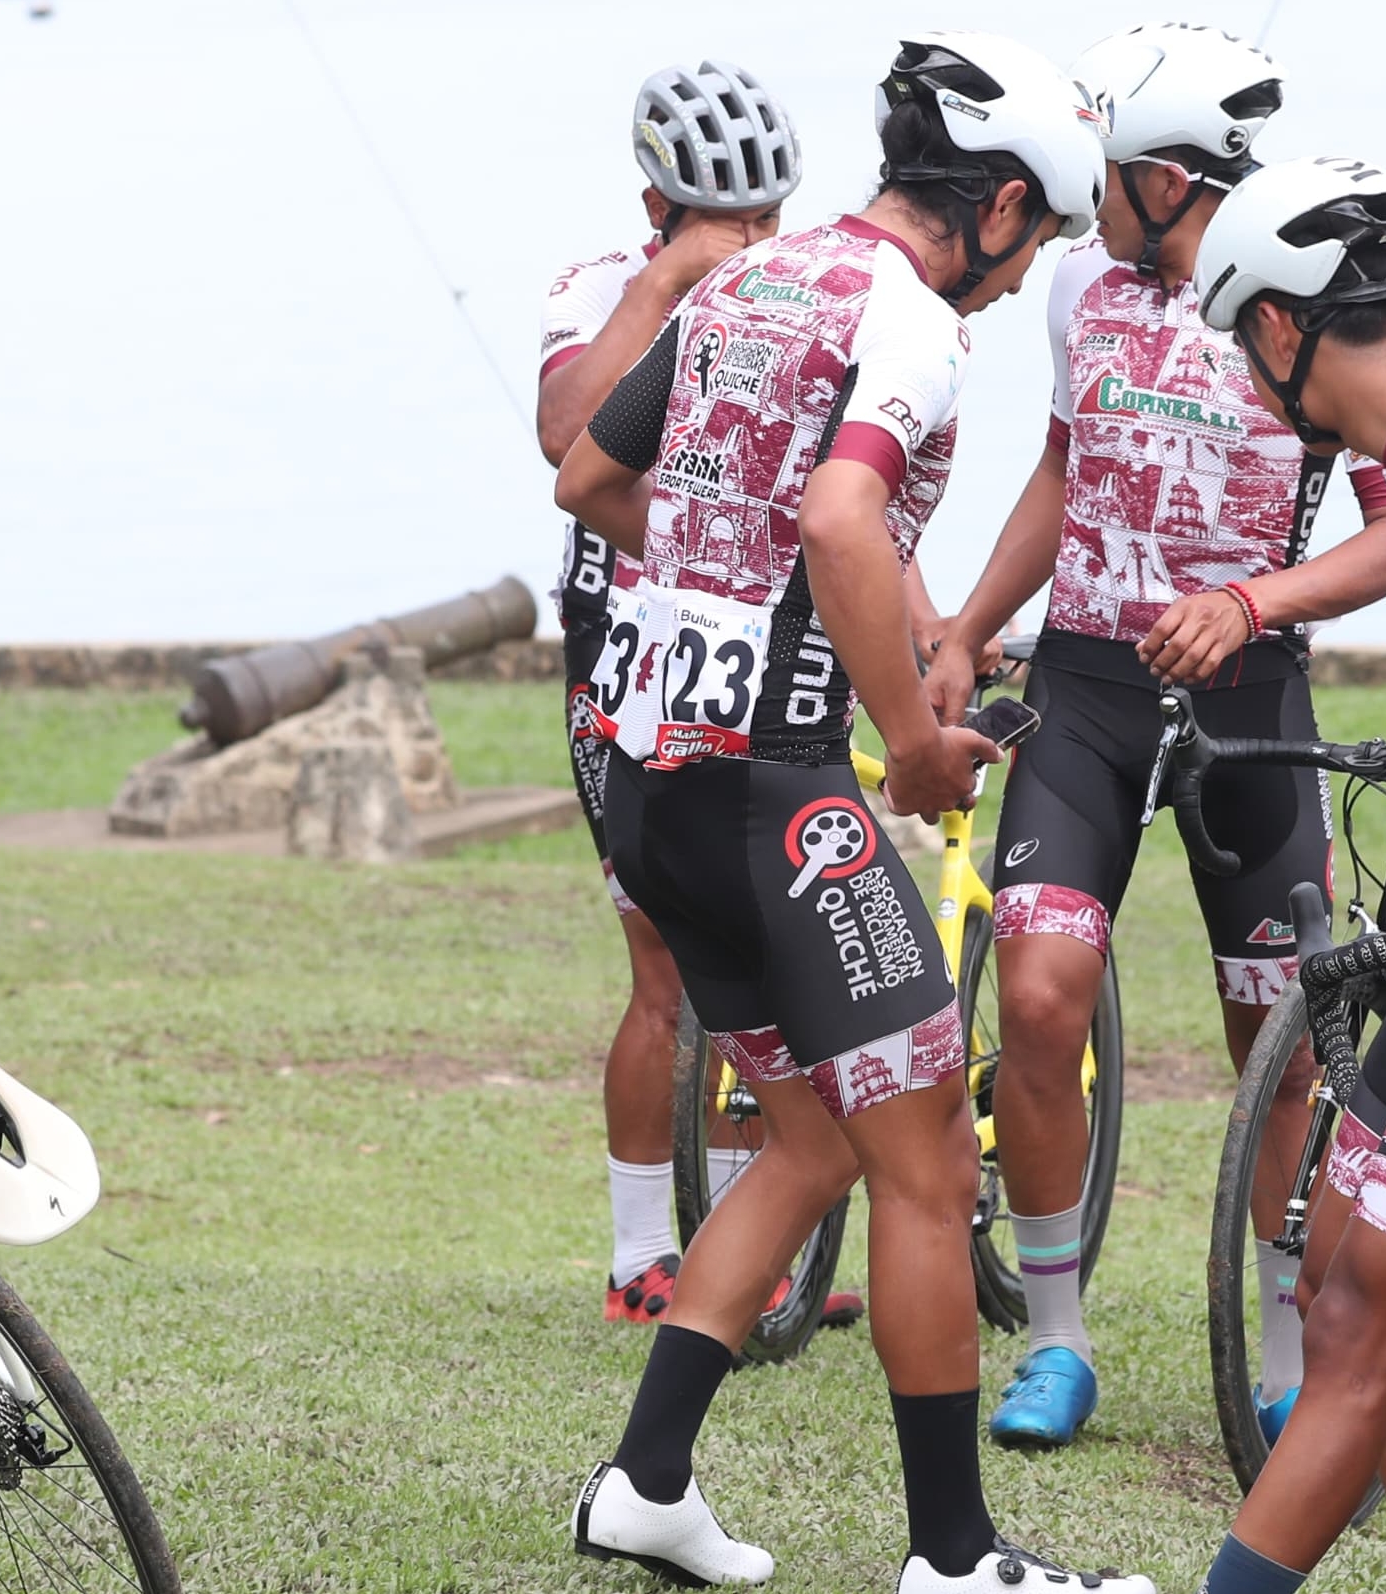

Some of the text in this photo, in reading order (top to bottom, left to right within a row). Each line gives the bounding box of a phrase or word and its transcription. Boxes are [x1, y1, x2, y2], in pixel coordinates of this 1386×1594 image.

[714, 370, 762, 394] QUICHÉ
[658, 473, 722, 502] SPORTSWEAR
[680, 609, 722, 632] Bulux
[816, 887, 885, 1002] QUICHÉ
[847, 874, 901, 988] DE CICLISMO
[862, 868, 912, 984] DEPARTAMENTAL
[873, 865, 925, 979] ASOCIACIÓN
